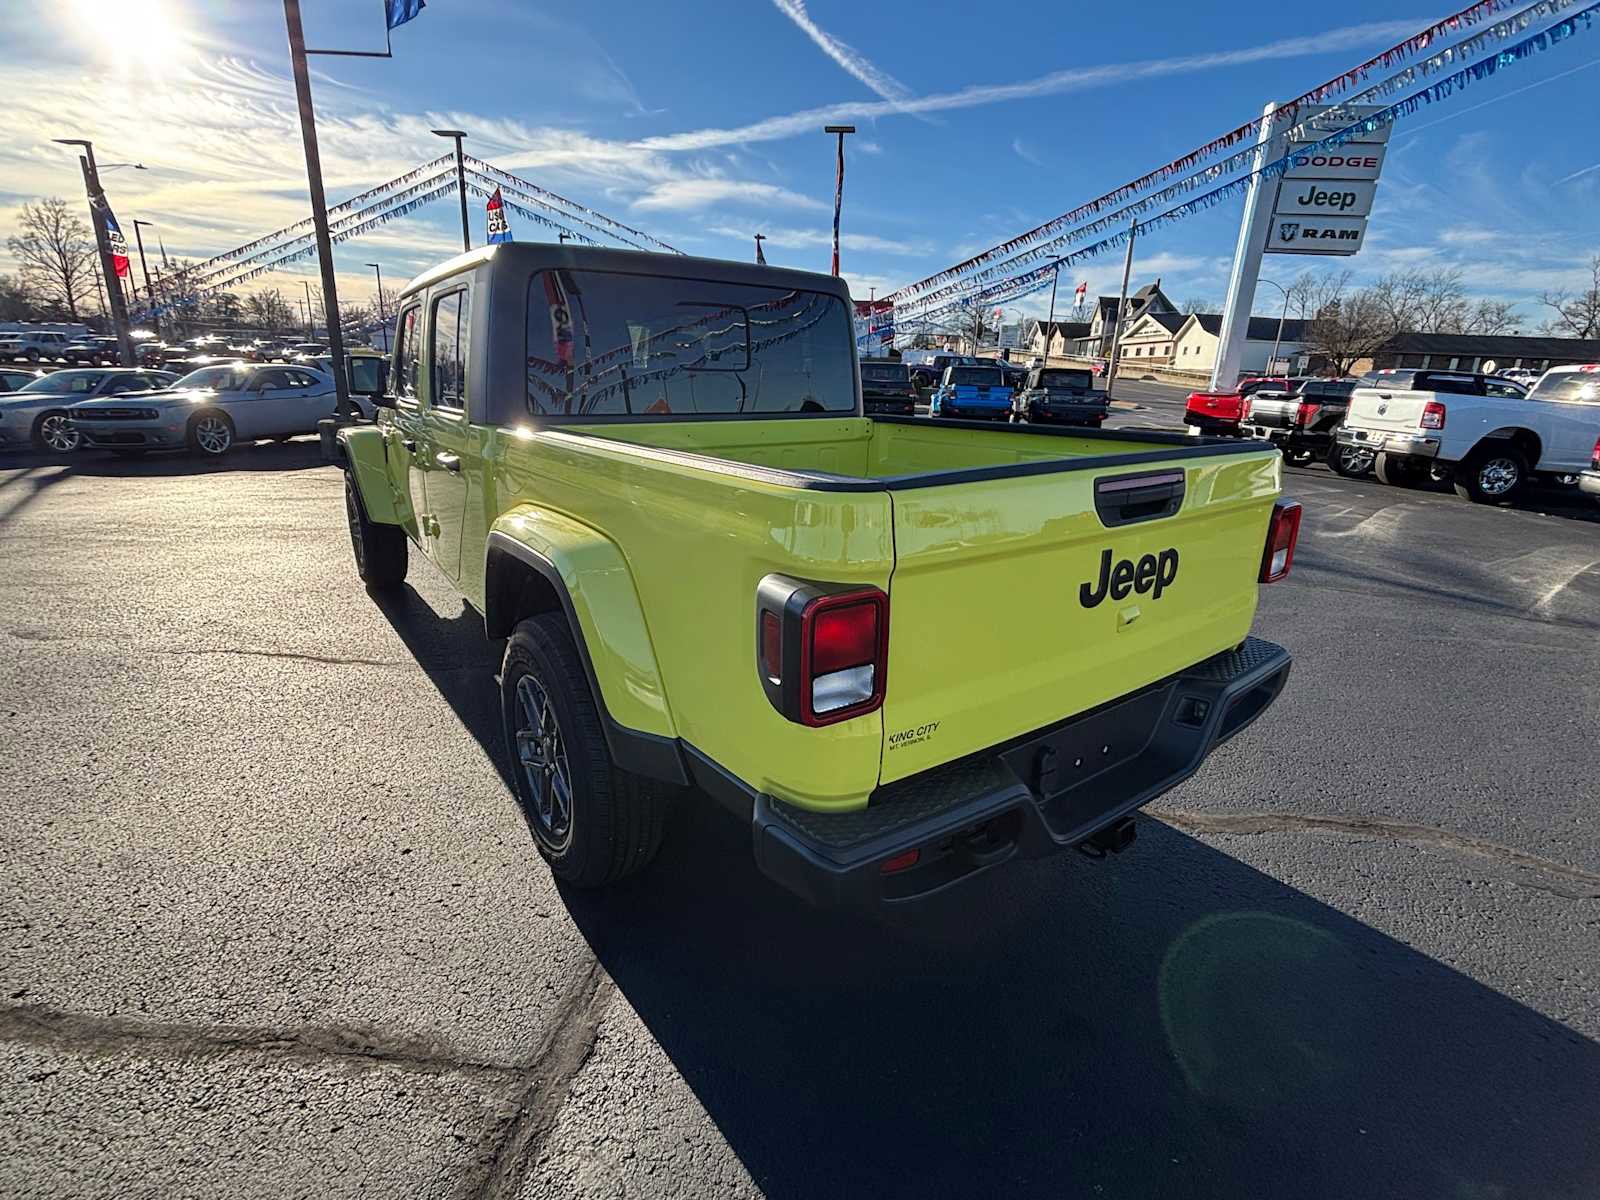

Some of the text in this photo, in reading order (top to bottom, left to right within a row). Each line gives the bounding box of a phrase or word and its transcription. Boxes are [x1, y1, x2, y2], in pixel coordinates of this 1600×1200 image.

[1296, 156, 1378, 168] DODGE
[1298, 186, 1356, 211] Jeep
[1302, 229, 1360, 240] RAM
[1080, 548, 1179, 608] Jeep
[889, 729, 914, 743] KING
[916, 721, 941, 736] CITY
